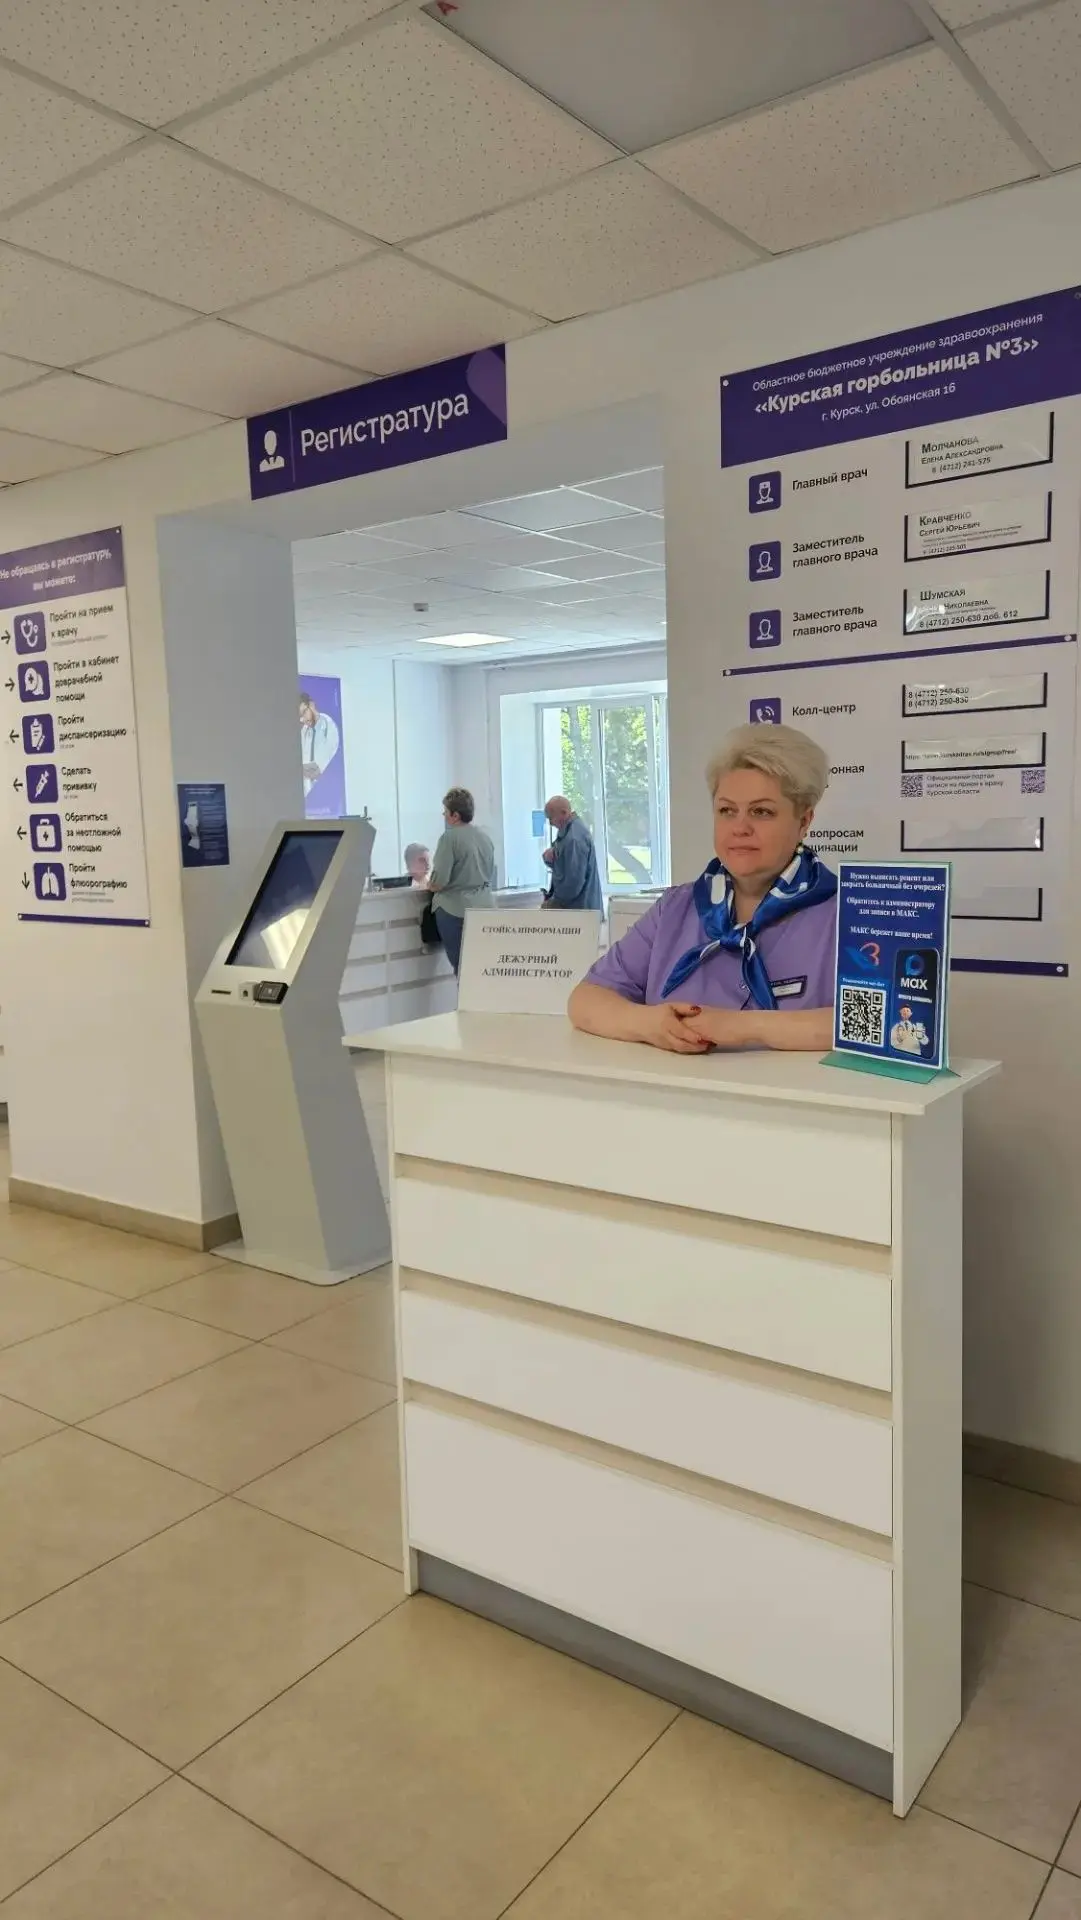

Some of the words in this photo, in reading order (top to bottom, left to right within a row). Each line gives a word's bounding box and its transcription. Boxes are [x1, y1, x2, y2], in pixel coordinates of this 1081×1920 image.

[752, 371, 806, 392] Областное
[807, 357, 866, 378] бюджетное
[868, 340, 936, 366] учреждение
[938, 313, 1044, 347] здравоохранения
[755, 383, 843, 414] «Курская
[847, 351, 980, 393] горбольница
[822, 413, 829, 421] г.
[865, 401, 880, 414] ул.
[881, 387, 941, 407] Обоянская
[942, 382, 956, 395] 16
[300, 393, 470, 456] Регистратура
[792, 473, 838, 491] Главный
[840, 468, 869, 483] врач
[792, 533, 865, 552] Заместитель
[792, 553, 842, 568] главного
[844, 546, 879, 560] врача
[11, 562, 50, 578] обращаясь
[50, 610, 77, 622] Пройти
[88, 604, 113, 616] прием
[792, 605, 864, 621] Заместитель
[926, 619, 950, 628] (4712)
[1003, 610, 1018, 619] 612
[57, 627, 78, 638] врачу
[792, 623, 841, 637] главного
[844, 618, 878, 632] врача
[53, 660, 80, 672] Пройти
[88, 655, 119, 666] кабинет
[55, 672, 103, 688] доврачебной
[56, 693, 85, 702] помощи
[792, 703, 857, 716] Колл-центр
[58, 715, 84, 725] Пройти
[59, 728, 127, 742] диспансеризацию
[61, 767, 91, 777] Сделать
[829, 765, 865, 775] онная
[63, 783, 97, 792] прививку
[65, 813, 108, 823] Обратиться
[75, 827, 122, 837] неотложной
[809, 829, 865, 840] вопросам
[67, 844, 103, 852] помощью
[808, 844, 858, 853] цинации
[69, 863, 96, 873] Пройти
[850, 872, 870, 881] Нужно
[71, 878, 128, 890] флюорографию
[865, 881, 902, 890] больничный
[885, 900, 936, 910] администратору
[482, 925, 515, 934] СТОЙКА
[518, 927, 581, 935] ИНФОРМАЦИИ
[850, 926, 870, 934] МАКС
[911, 932, 933, 940] время!
[497, 954, 558, 964] ДЕЖУРНЫЙ
[481, 967, 573, 978] АДМИНИСТРАТОР
